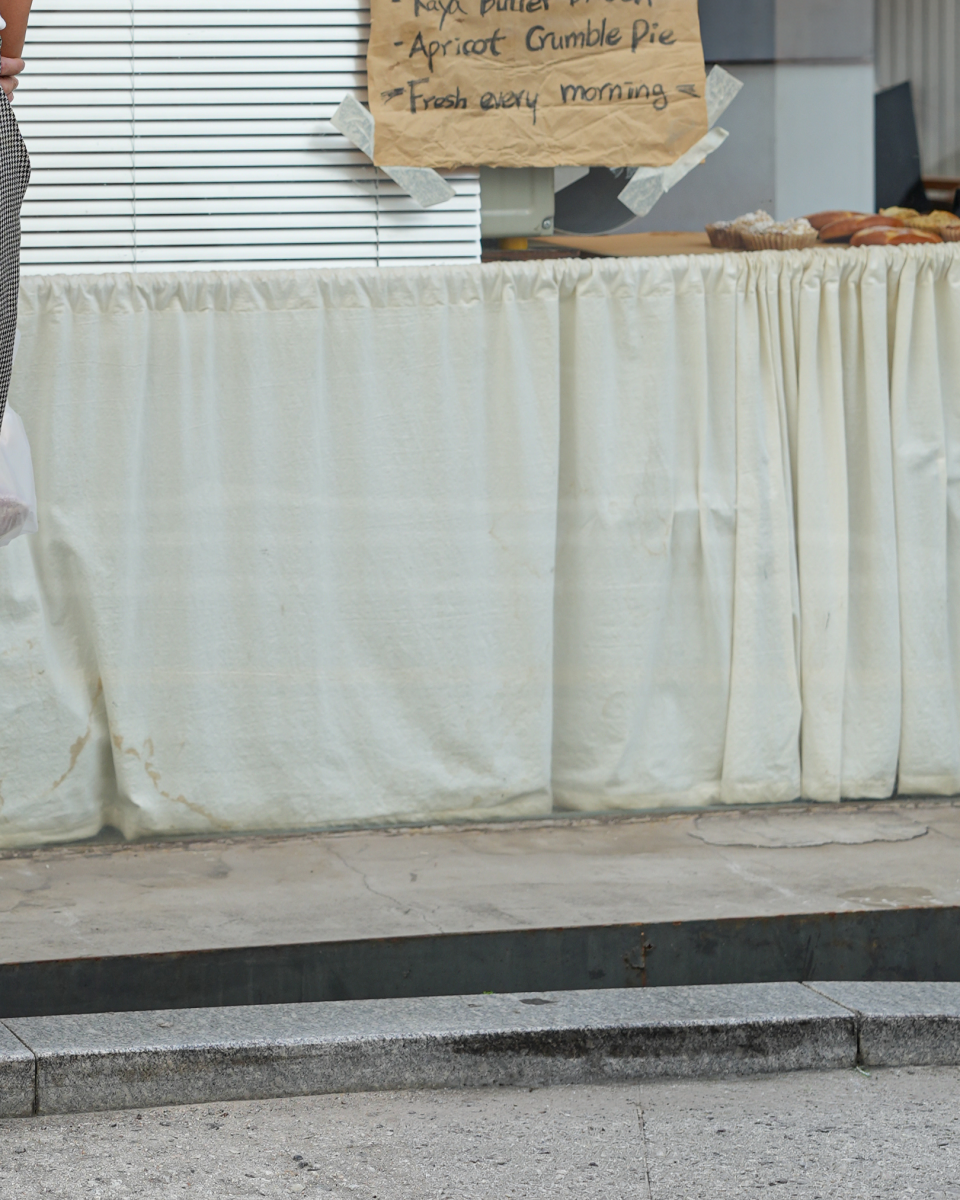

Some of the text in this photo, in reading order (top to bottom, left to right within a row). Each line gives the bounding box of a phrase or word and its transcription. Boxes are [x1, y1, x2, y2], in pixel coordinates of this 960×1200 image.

[408, 17, 678, 73] Apricot Crumble Pie
[479, 88, 540, 126] every
[559, 81, 668, 111] morning
